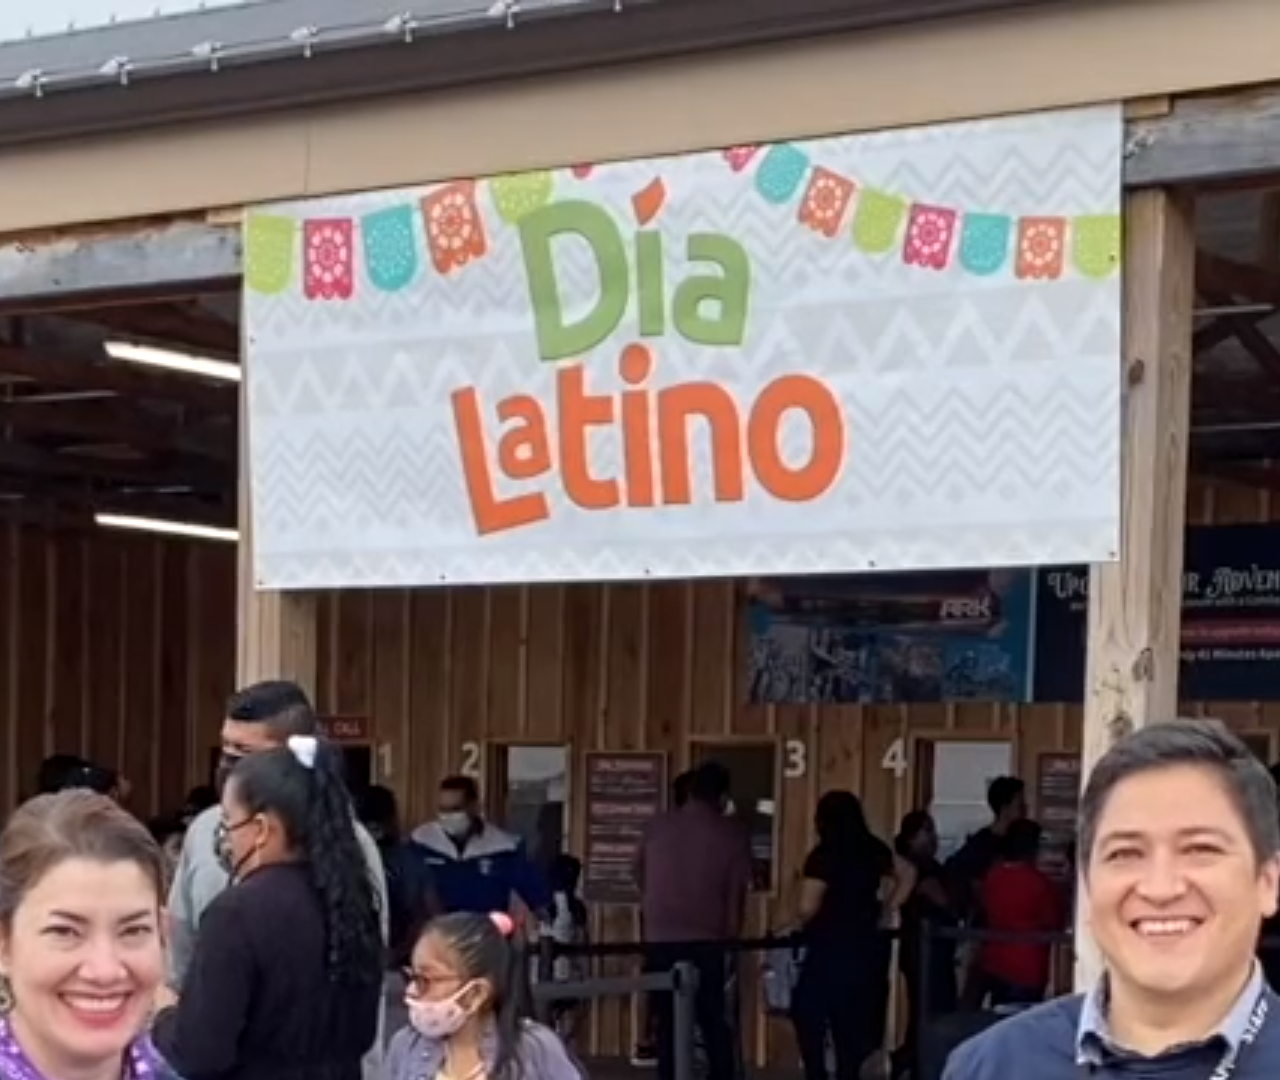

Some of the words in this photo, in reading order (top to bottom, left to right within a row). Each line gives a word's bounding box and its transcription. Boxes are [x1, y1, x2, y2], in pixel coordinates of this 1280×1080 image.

[519, 176, 750, 361] Día
[451, 343, 844, 536] Latino
[940, 596, 992, 617] ARK
[378, 742, 393, 777] 1
[460, 740, 481, 777] 2
[784, 739, 807, 778] 3
[881, 739, 908, 778] 4
